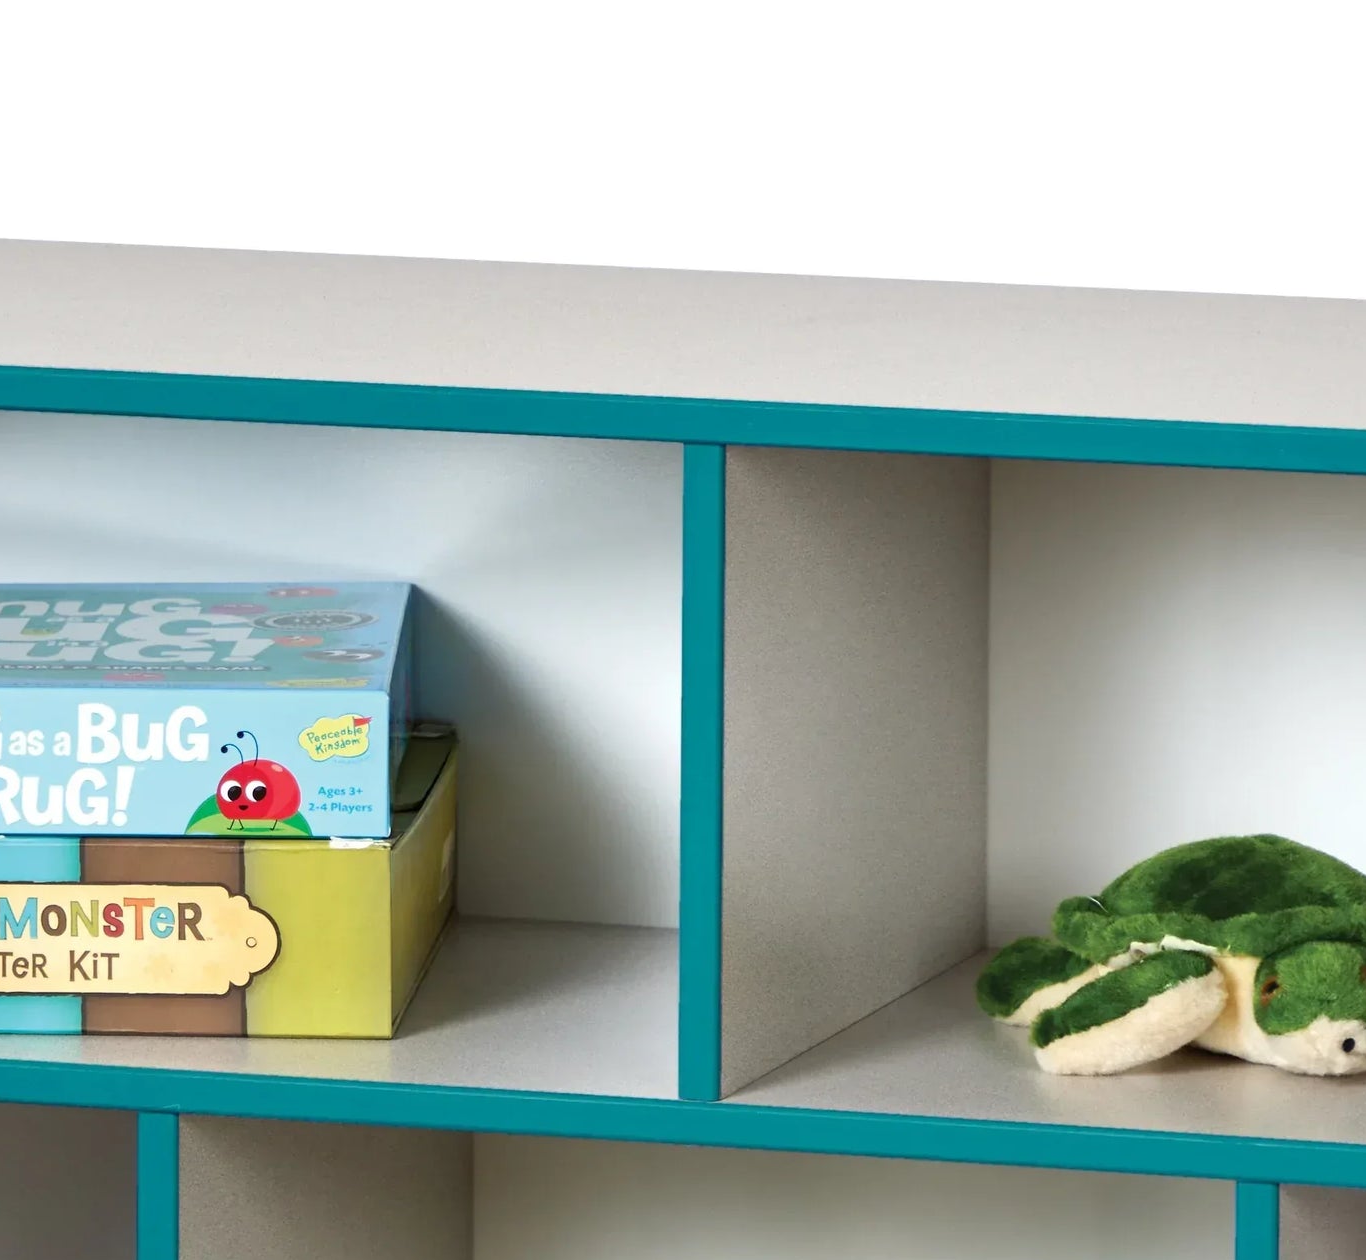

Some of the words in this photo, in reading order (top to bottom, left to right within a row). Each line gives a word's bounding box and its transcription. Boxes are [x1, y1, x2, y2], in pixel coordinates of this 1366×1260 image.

[9, 729, 44, 756] as
[53, 731, 72, 756] a
[307, 726, 363, 744] Peaceable
[316, 738, 361, 754] Kingdom
[318, 786, 346, 798] Ages
[348, 786, 363, 796] 3+
[308, 802, 328, 811] 2-4
[331, 802, 373, 814] Players
